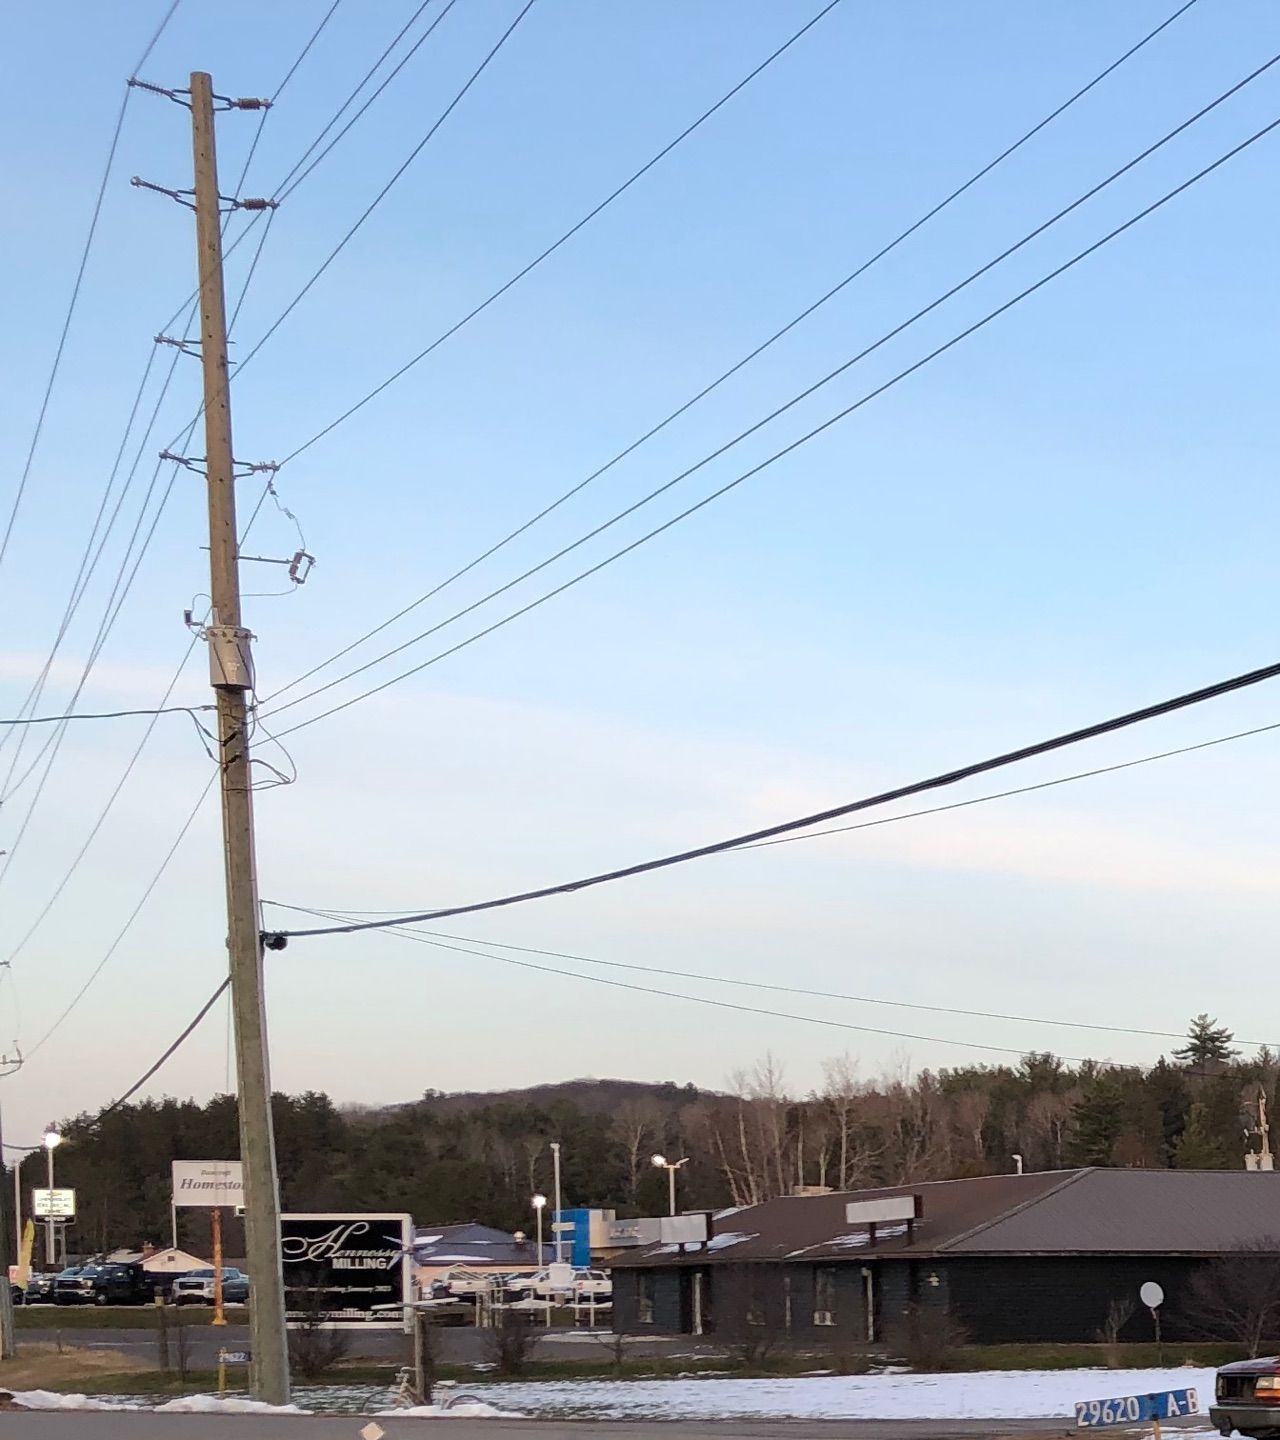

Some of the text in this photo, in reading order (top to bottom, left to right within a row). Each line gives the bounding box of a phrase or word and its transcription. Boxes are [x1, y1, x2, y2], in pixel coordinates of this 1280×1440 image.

[332, 1258, 387, 1270] MILLING
[1076, 1390, 1200, 1427] 29620 A-B
